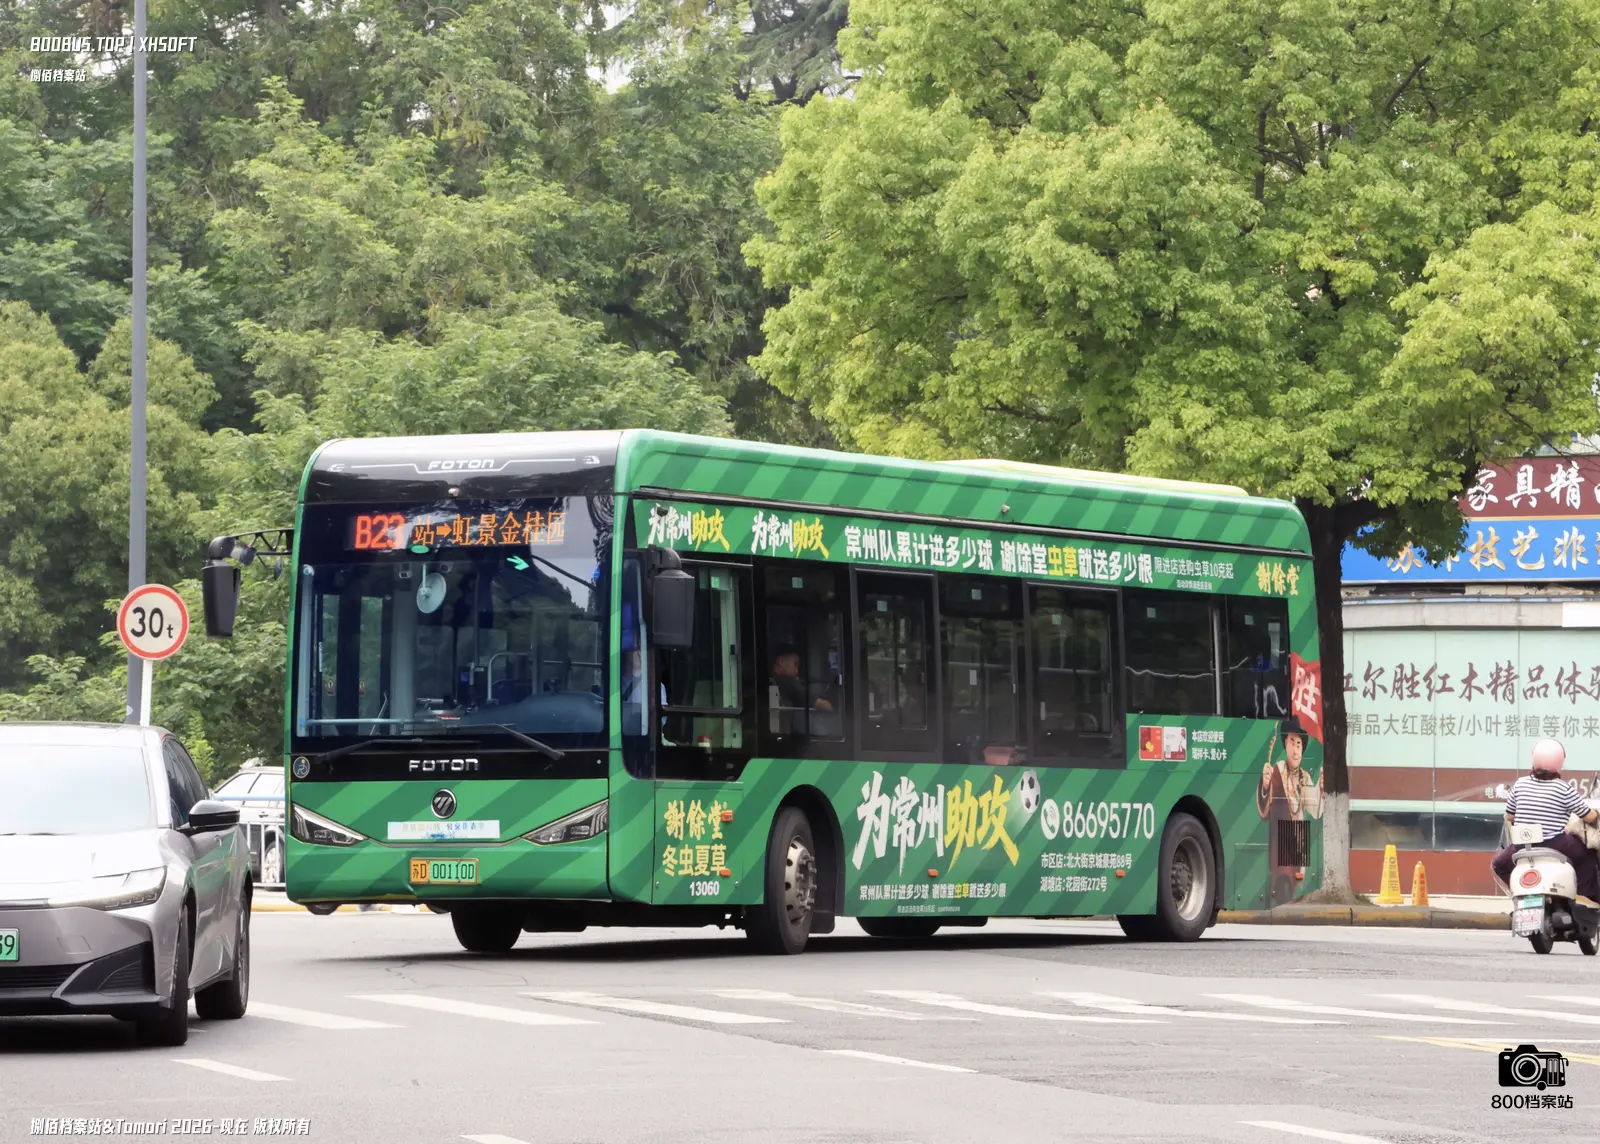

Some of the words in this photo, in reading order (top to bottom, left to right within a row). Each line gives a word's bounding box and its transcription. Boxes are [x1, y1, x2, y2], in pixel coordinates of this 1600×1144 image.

[427, 458, 495, 471] FOTON
[1467, 460, 1600, 512] 家具精
[452, 511, 567, 546] 虹景金桂园
[648, 503, 731, 552] 为常州助攻
[751, 510, 830, 560] 为常州助攻
[844, 524, 994, 572] 常州队累计进多少球
[1154, 556, 1234, 579] 限进店选购虫草10克起
[408, 758, 479, 772] FOTON
[852, 770, 1020, 877] 为常州助攻
[1062, 800, 1155, 841] 86695770
[662, 844, 727, 877] 冬虫夏草
[689, 881, 720, 897] 13060
[859, 884, 930, 901] 常州队累计进多少球
